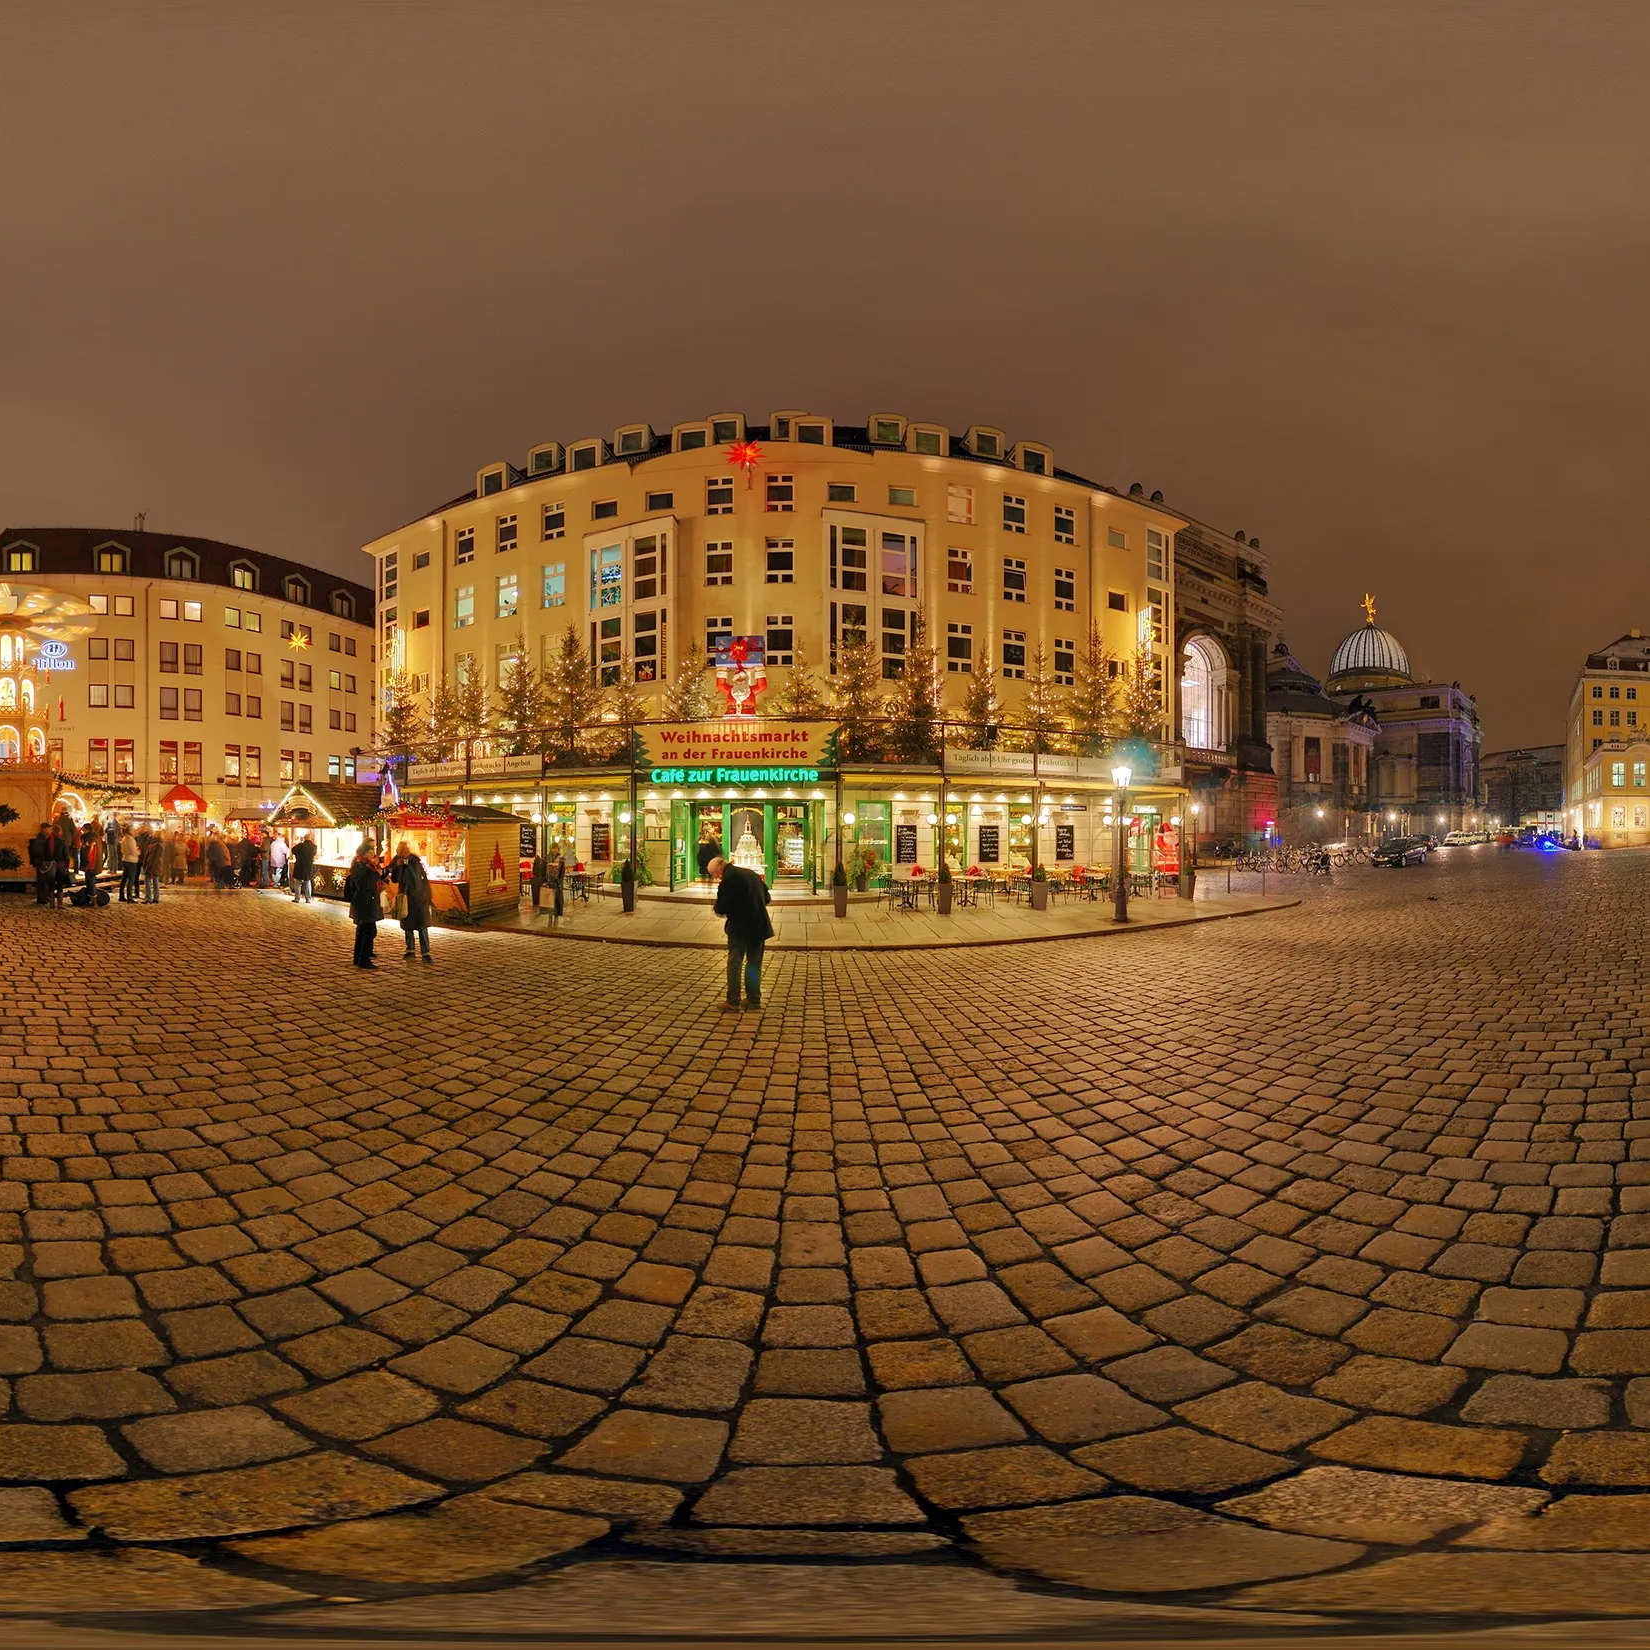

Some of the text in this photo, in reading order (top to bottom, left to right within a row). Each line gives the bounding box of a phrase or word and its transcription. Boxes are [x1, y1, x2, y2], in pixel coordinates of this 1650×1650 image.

[32, 657, 75, 670] Hilton
[660, 729, 809, 744] Weihnachtsmarkt
[661, 747, 808, 759] an der Frauenkirche
[952, 754, 979, 762] Täglich
[1012, 757, 1033, 766] großes
[412, 767, 428, 776] Täglich
[506, 760, 530, 768] Angebot
[651, 767, 819, 783] Café zur Frauenkirche
